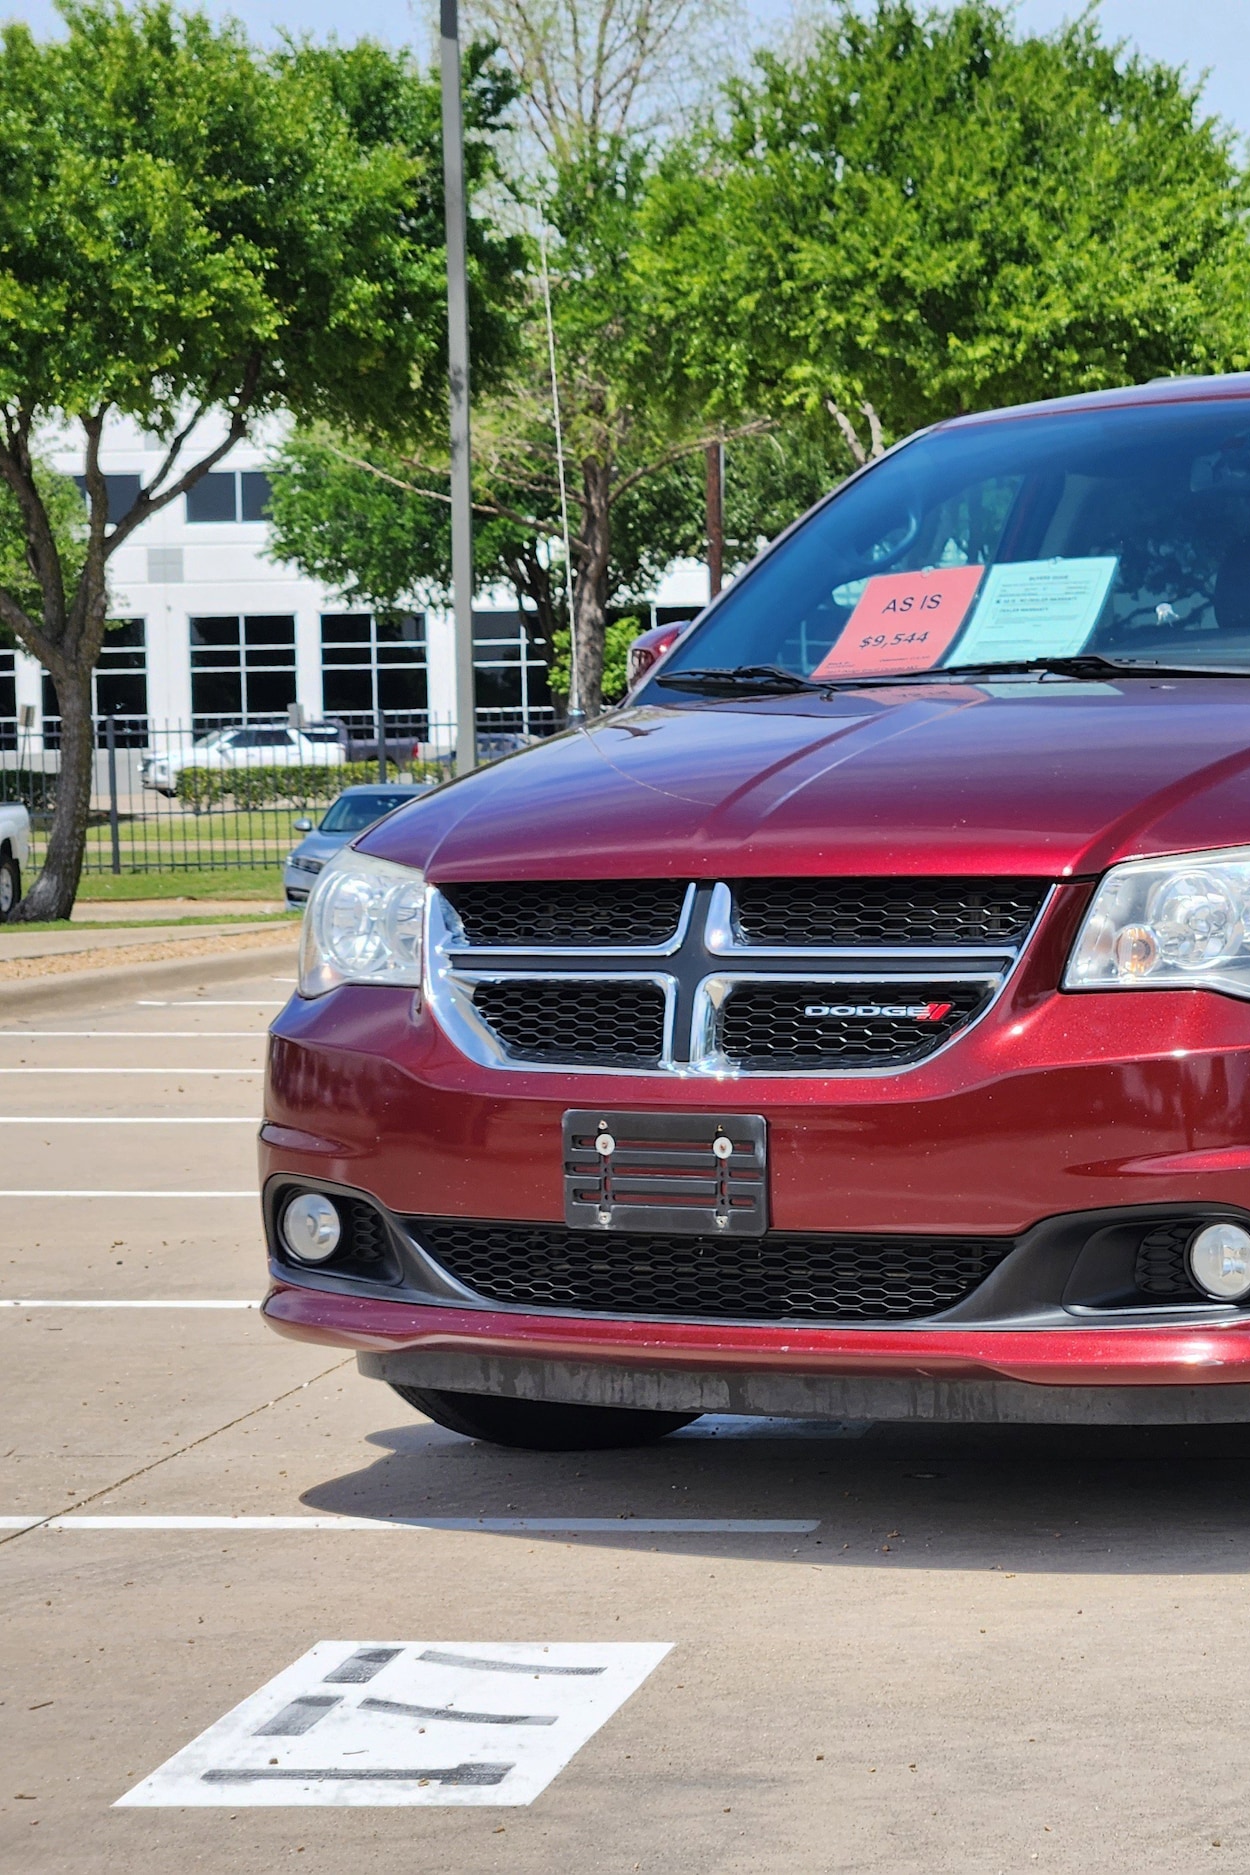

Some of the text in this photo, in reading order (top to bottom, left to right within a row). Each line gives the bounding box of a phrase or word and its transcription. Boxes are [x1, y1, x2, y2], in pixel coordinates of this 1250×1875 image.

[881, 593, 944, 614] AS IS
[858, 630, 930, 649] $9,544
[804, 1005, 931, 1017] DODGE
